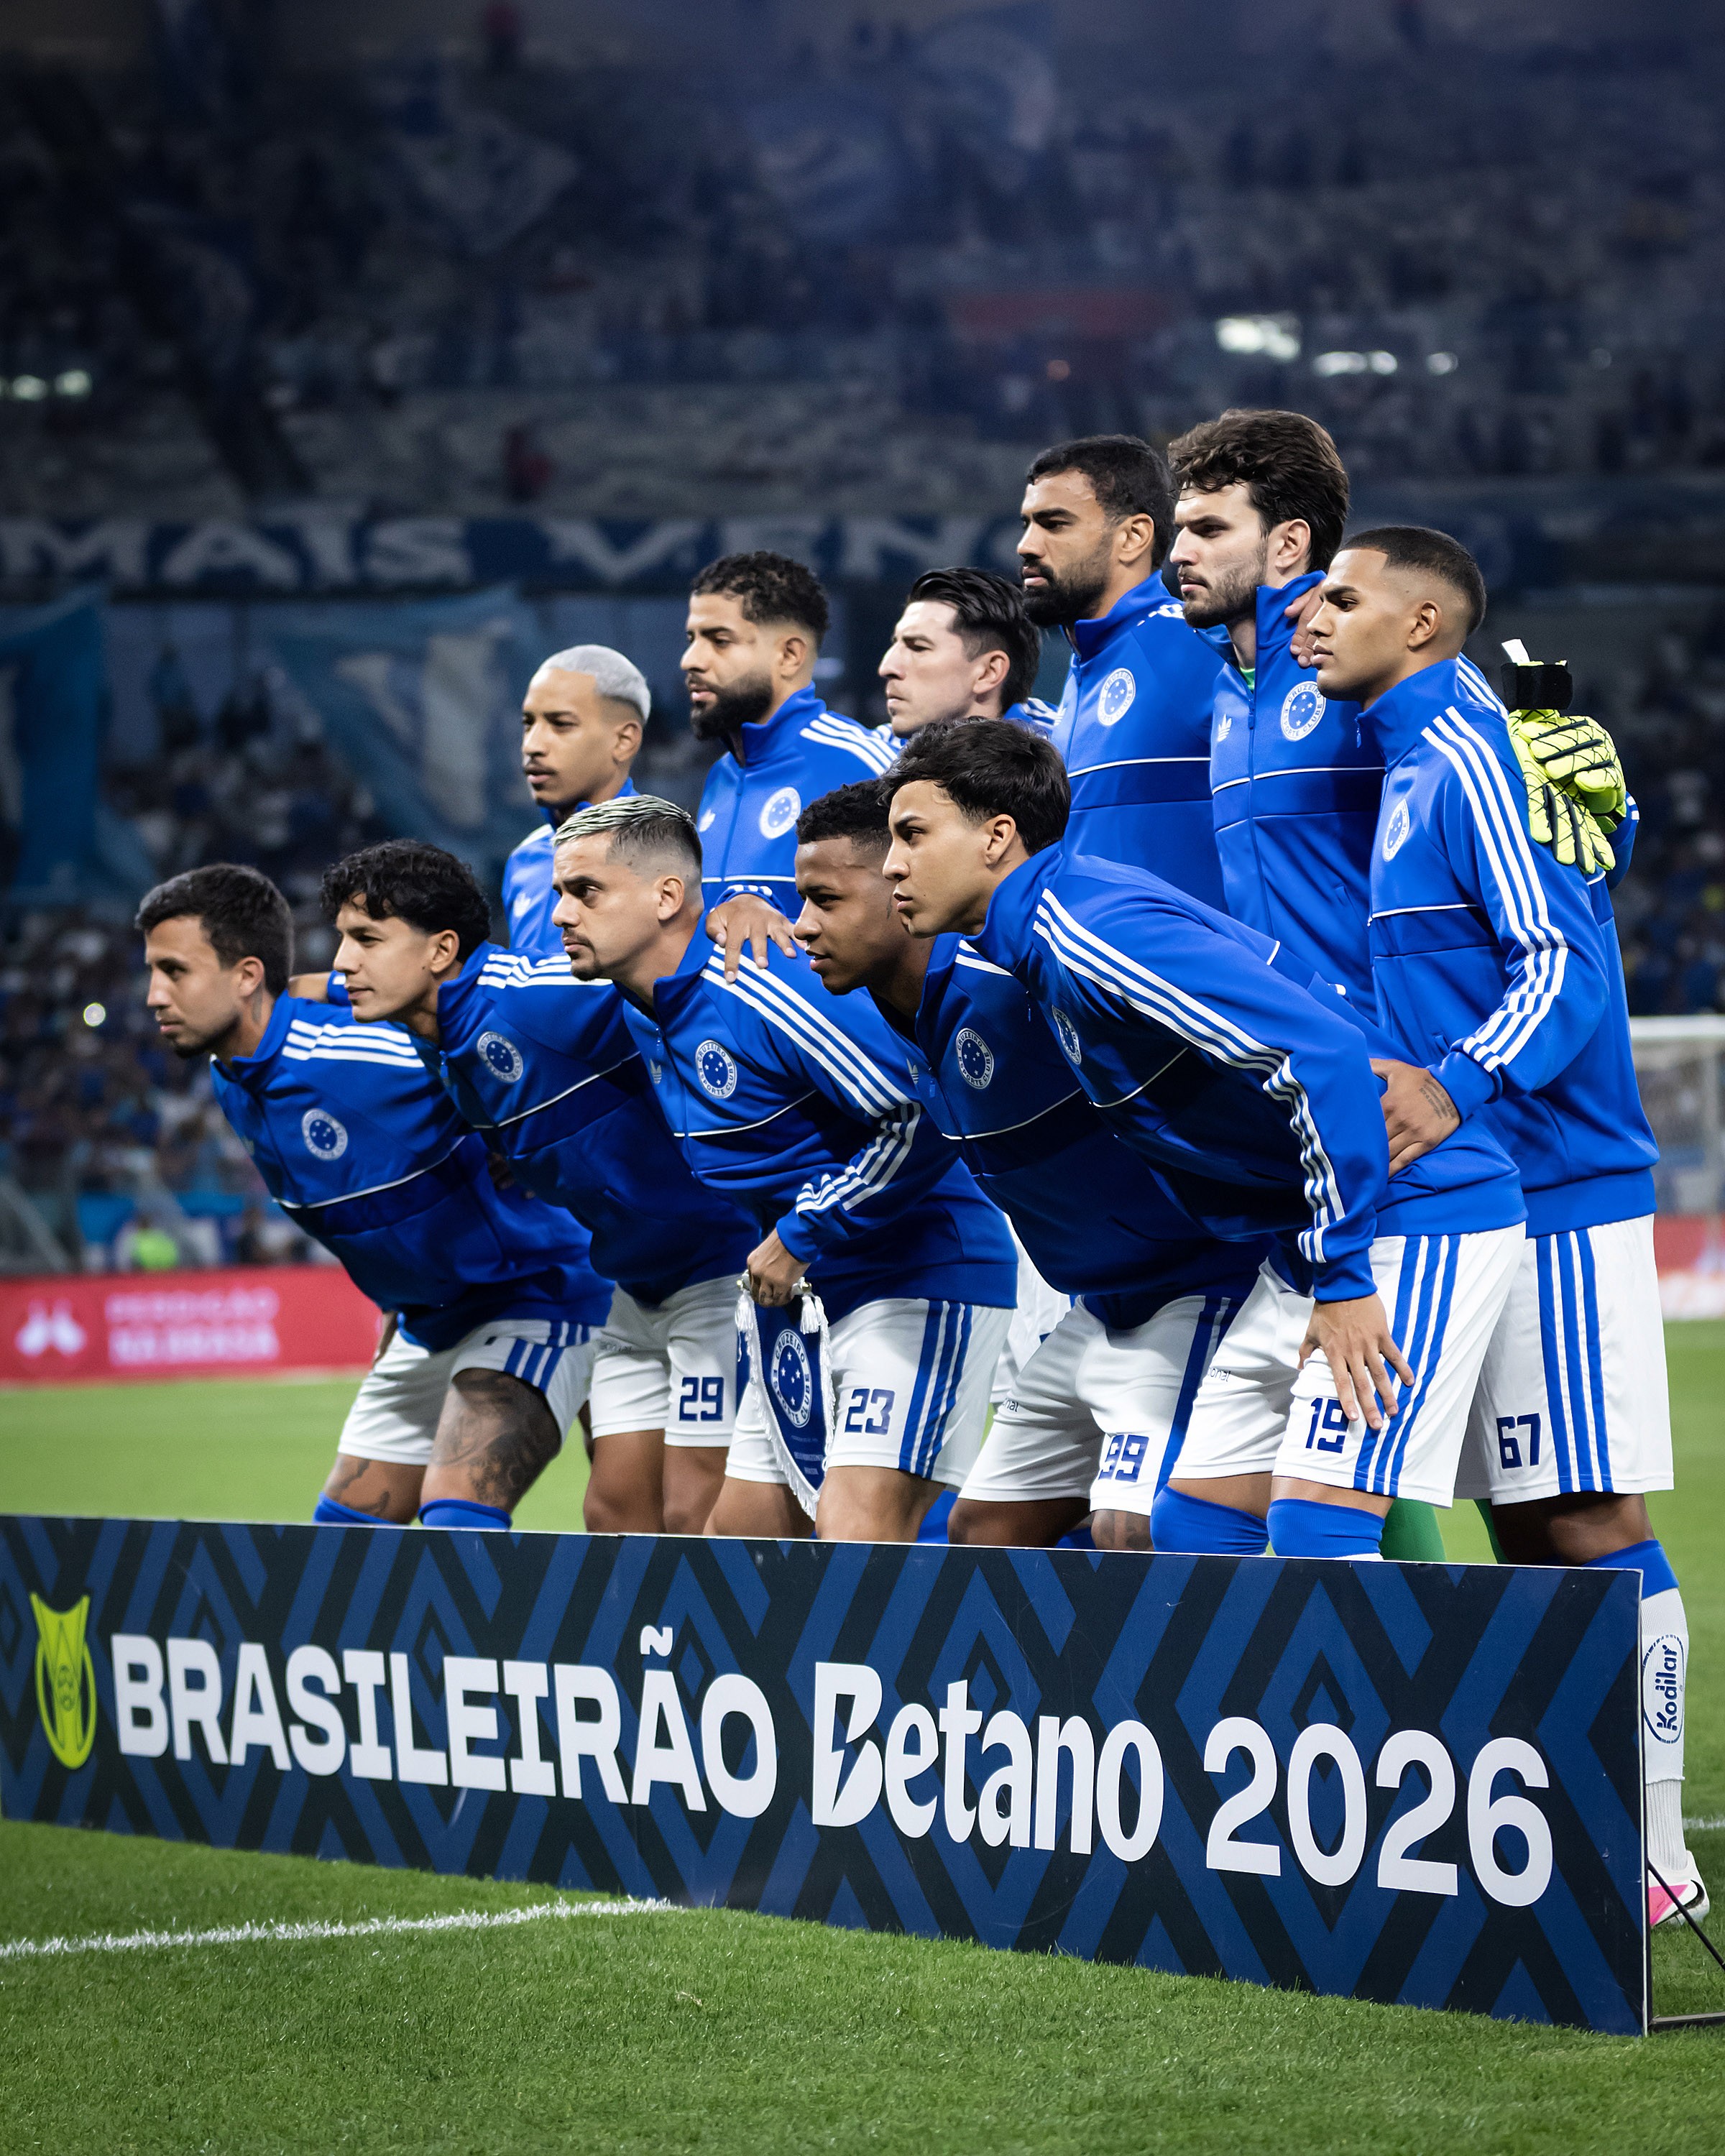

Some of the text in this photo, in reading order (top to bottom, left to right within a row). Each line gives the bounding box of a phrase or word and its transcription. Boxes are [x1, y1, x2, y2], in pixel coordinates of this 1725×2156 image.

[1, 516, 472, 587] MAIS
[776, 1333, 806, 1363] CRUZEIRO
[679, 1376, 724, 1422] 29
[845, 1388, 895, 1435] 23
[1305, 1397, 1350, 1454] 19
[1098, 1434, 1150, 1483] 99
[1496, 1412, 1541, 1469] 67
[1655, 1644, 1678, 1731] Kodilar
[111, 1625, 1553, 1907] BRASILEIRÃO Betano 2026
